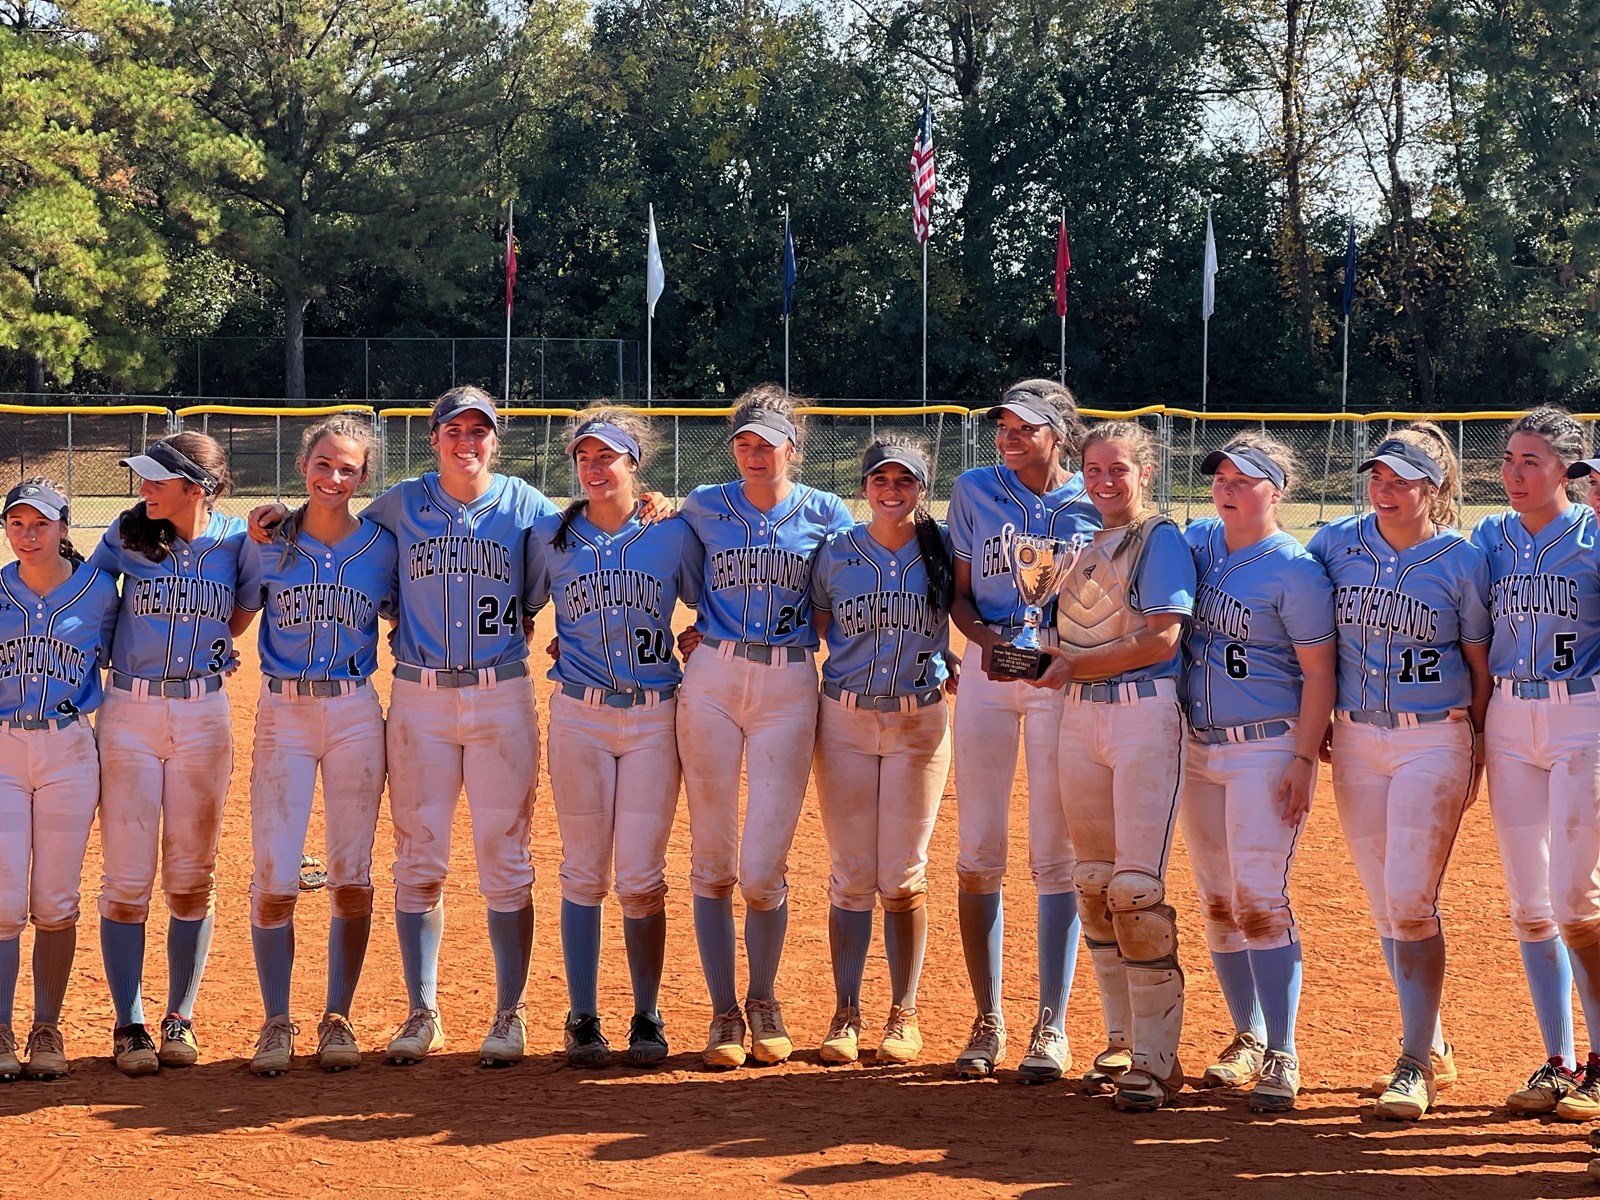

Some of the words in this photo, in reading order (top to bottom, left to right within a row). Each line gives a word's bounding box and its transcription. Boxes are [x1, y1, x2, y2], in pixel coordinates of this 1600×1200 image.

[409, 536, 511, 584] GREYHOUNDS
[711, 547, 809, 595] GREYHOUNDS
[477, 595, 519, 637] 24
[564, 569, 663, 623] GREYHOUNDS
[1333, 585, 1440, 643] REYHOUNDS
[207, 638, 227, 673] 3
[634, 627, 672, 666] 20
[1224, 642, 1249, 680] 6
[1398, 647, 1442, 684] 12
[1552, 632, 1578, 673] 5
[913, 650, 933, 688] 7
